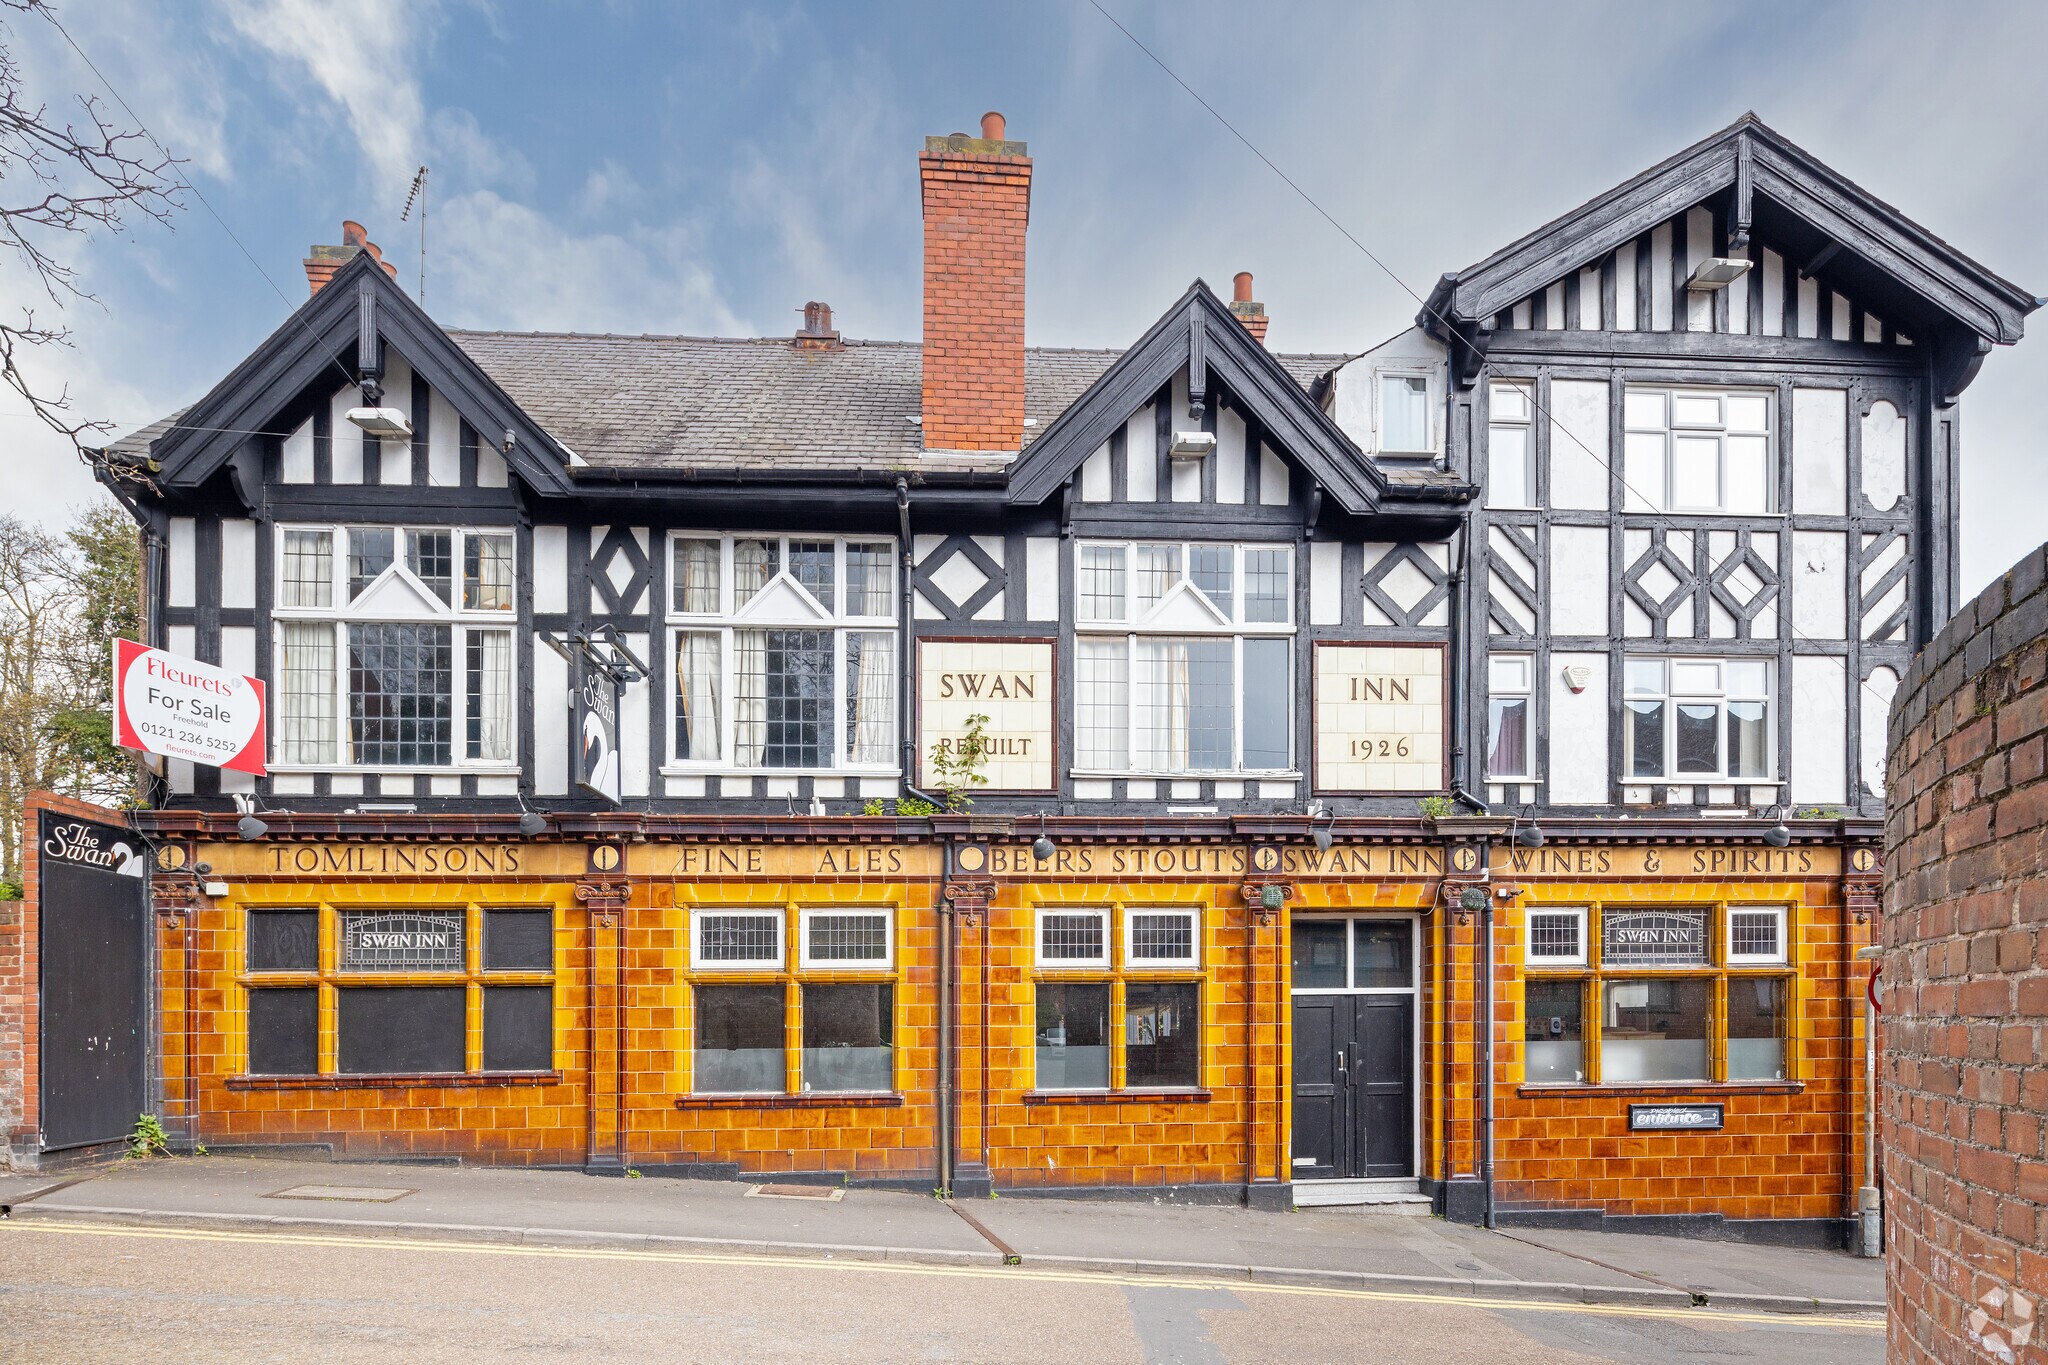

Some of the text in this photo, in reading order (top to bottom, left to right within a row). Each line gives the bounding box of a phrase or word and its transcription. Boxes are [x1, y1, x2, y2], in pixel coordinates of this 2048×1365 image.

[147, 657, 232, 697] Fleurets
[594, 674, 609, 703] The
[940, 674, 1034, 698] SWAN
[1351, 677, 1410, 701] INN
[148, 687, 231, 723] For Sale
[583, 674, 615, 726] Swan
[173, 713, 209, 729] Freehold
[141, 721, 237, 753] 0121 236 5252
[1351, 736, 1409, 760] 1926
[165, 744, 216, 760] fleurets.com
[44, 826, 113, 867] Swan
[66, 823, 99, 848] The
[268, 845, 519, 873] TOMLINSON'S
[681, 848, 902, 873] FINE ALES
[1112, 848, 1245, 873] STOUTS
[1283, 849, 1443, 873] SWAN INN
[1507, 849, 1813, 873] WINES & SPIRITS
[361, 933, 447, 948] SWAN INN
[1617, 929, 1690, 943] SWAN INN
[1636, 1112, 1704, 1126] entrance
